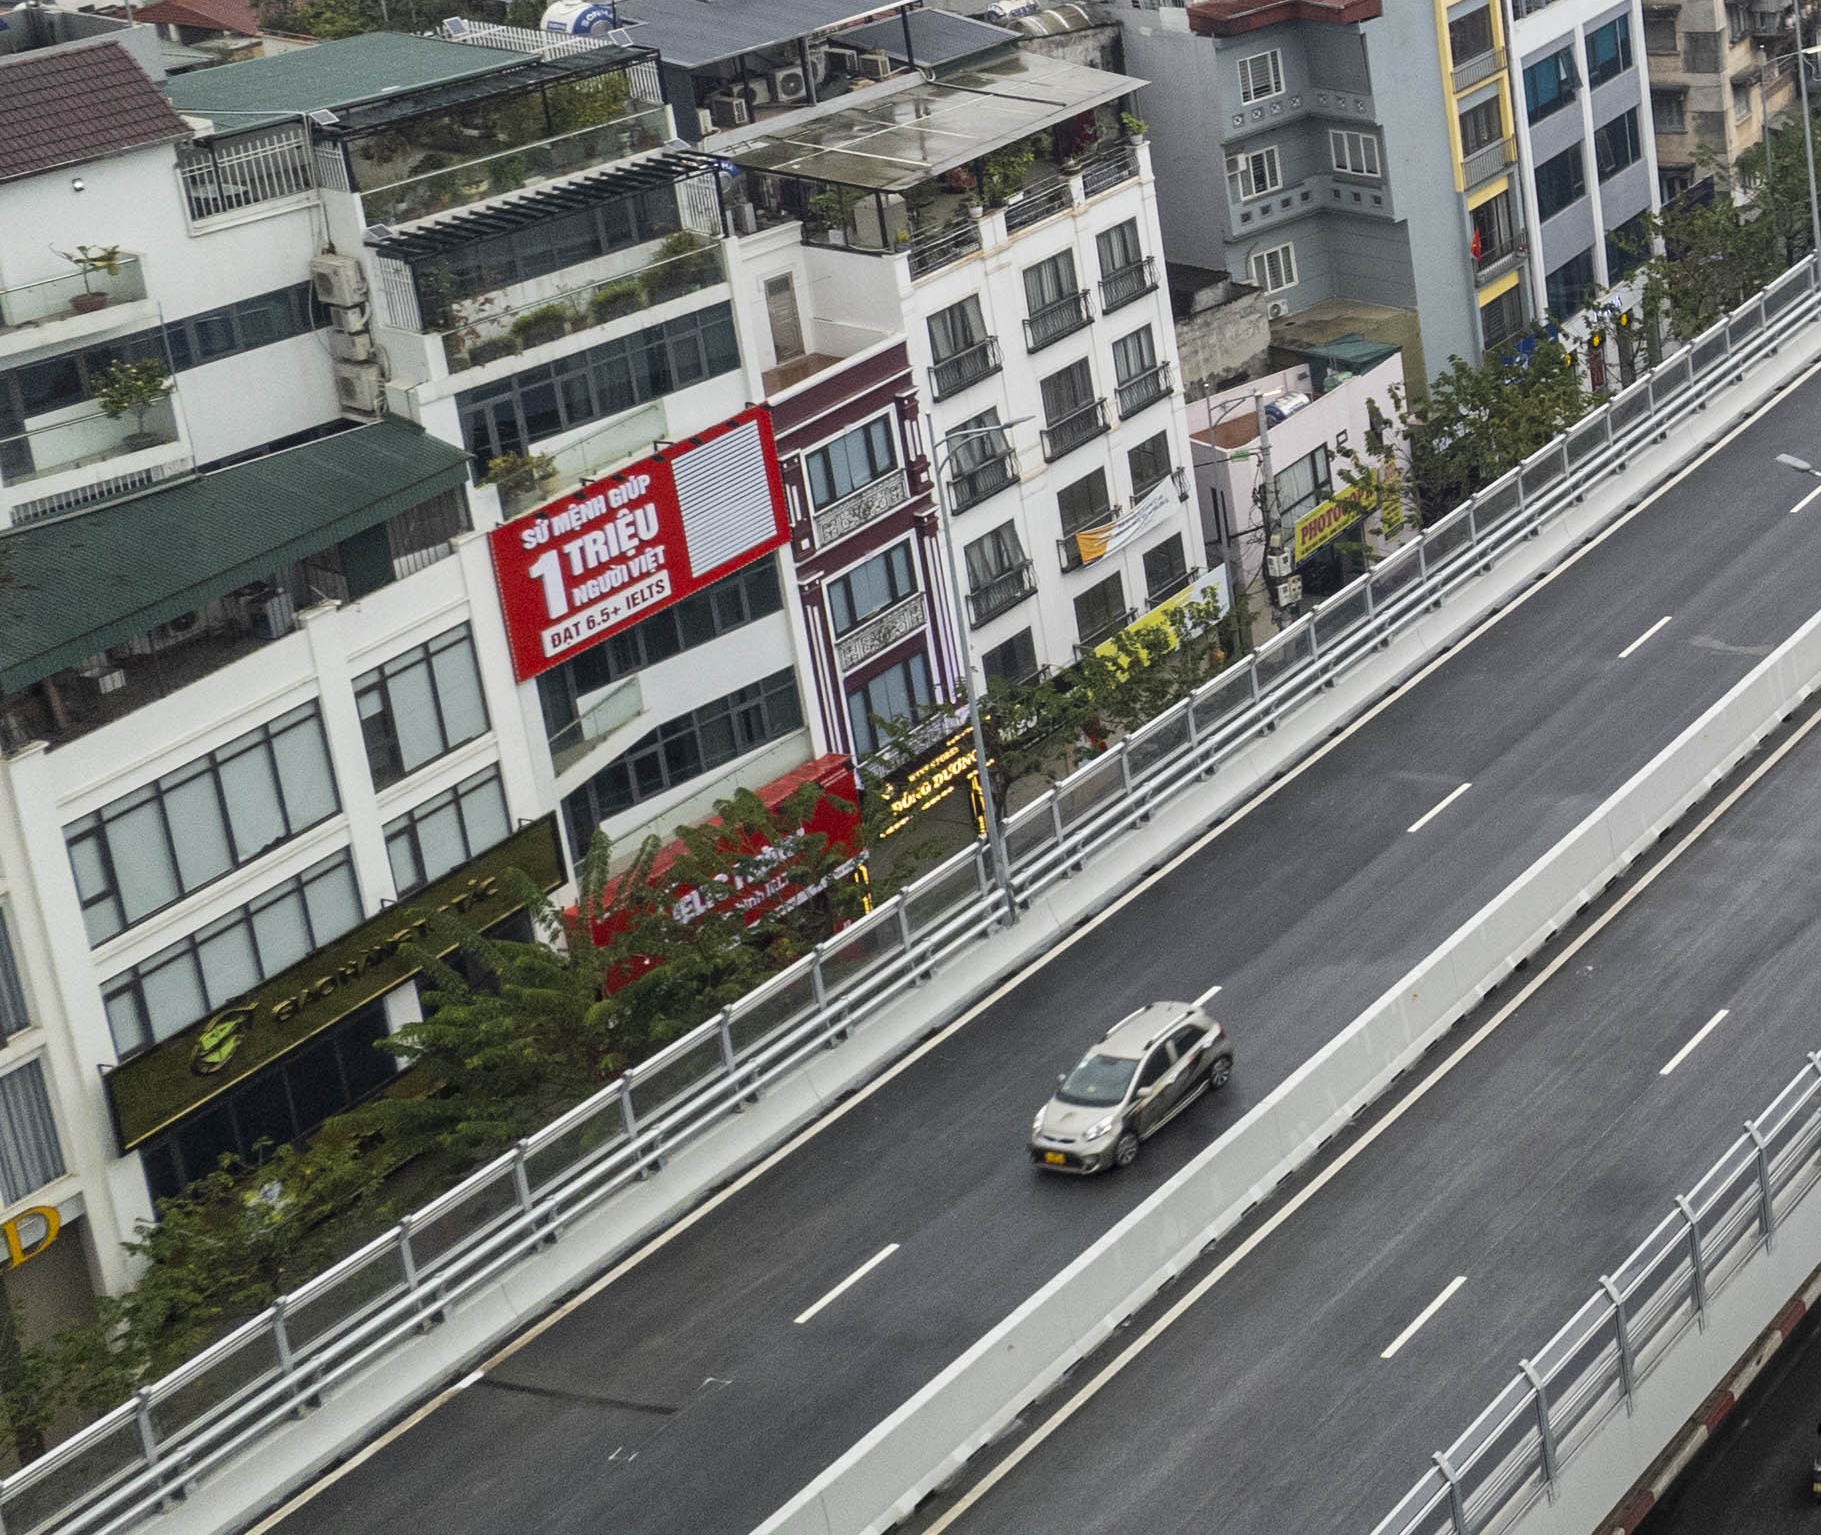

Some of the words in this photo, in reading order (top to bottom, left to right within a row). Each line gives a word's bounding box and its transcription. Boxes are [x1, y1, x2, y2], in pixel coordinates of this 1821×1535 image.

[551, 494, 607, 536] MỆNH
[608, 473, 651, 509] GIÚP
[528, 549, 568, 620] 1
[562, 502, 659, 577] TRIỆU
[572, 564, 629, 607] NGƯỜI
[627, 544, 665, 577] VIỆT
[551, 621, 582, 649] ĐẠT
[586, 604, 622, 631] 6.5+
[625, 578, 666, 611] IELTS
